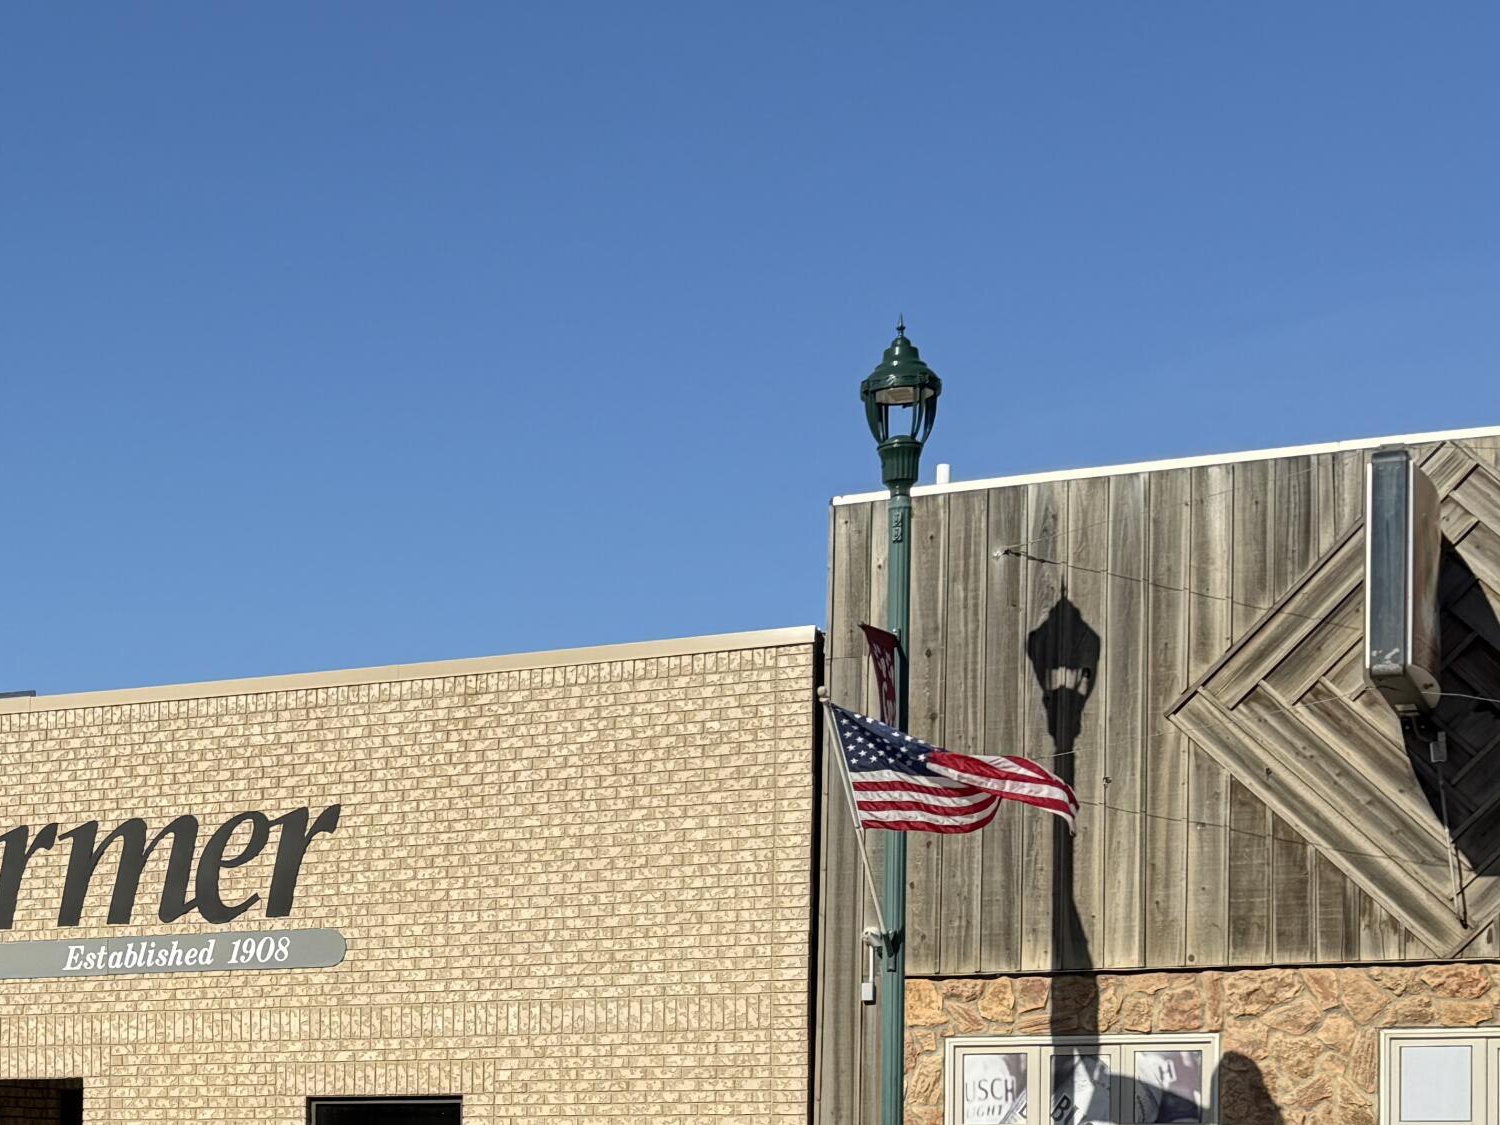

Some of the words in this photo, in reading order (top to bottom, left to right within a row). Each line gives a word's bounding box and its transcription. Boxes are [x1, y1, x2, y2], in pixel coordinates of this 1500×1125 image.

[63, 940, 215, 972] Established
[228, 936, 291, 964] 1908
[965, 1076, 1016, 1102] USCH
